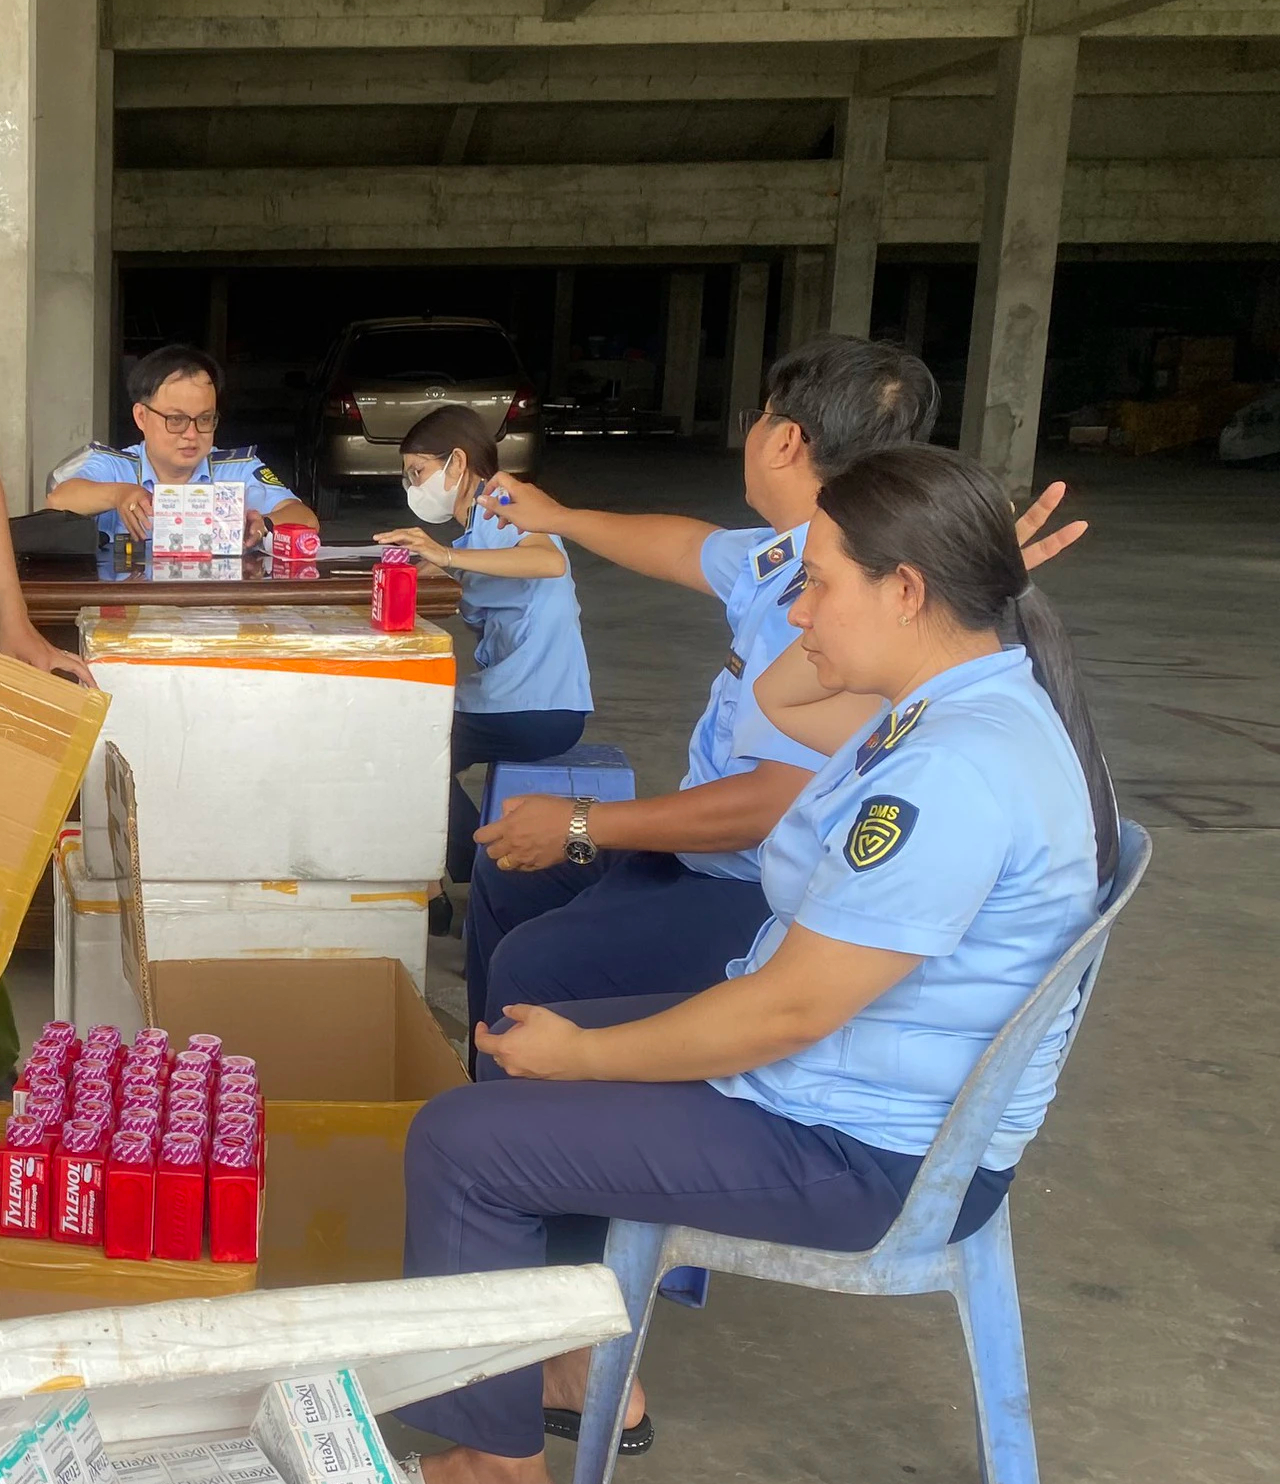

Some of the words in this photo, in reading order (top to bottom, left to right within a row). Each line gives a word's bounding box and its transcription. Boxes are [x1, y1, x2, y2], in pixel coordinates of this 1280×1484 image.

[868, 805, 900, 820] DMS
[5, 1157, 23, 1227] TYLENOL
[62, 1163, 80, 1233] TYLENOL
[88, 1190, 96, 1217] Strength
[295, 1384, 319, 1423] EtiaXil
[160, 1447, 206, 1461] EtiaXil
[209, 1439, 255, 1452] EtiaXil
[314, 1432, 338, 1473] EtiaXil
[112, 1454, 157, 1470] EtiaXil
[228, 1466, 275, 1481] EtiaXil
